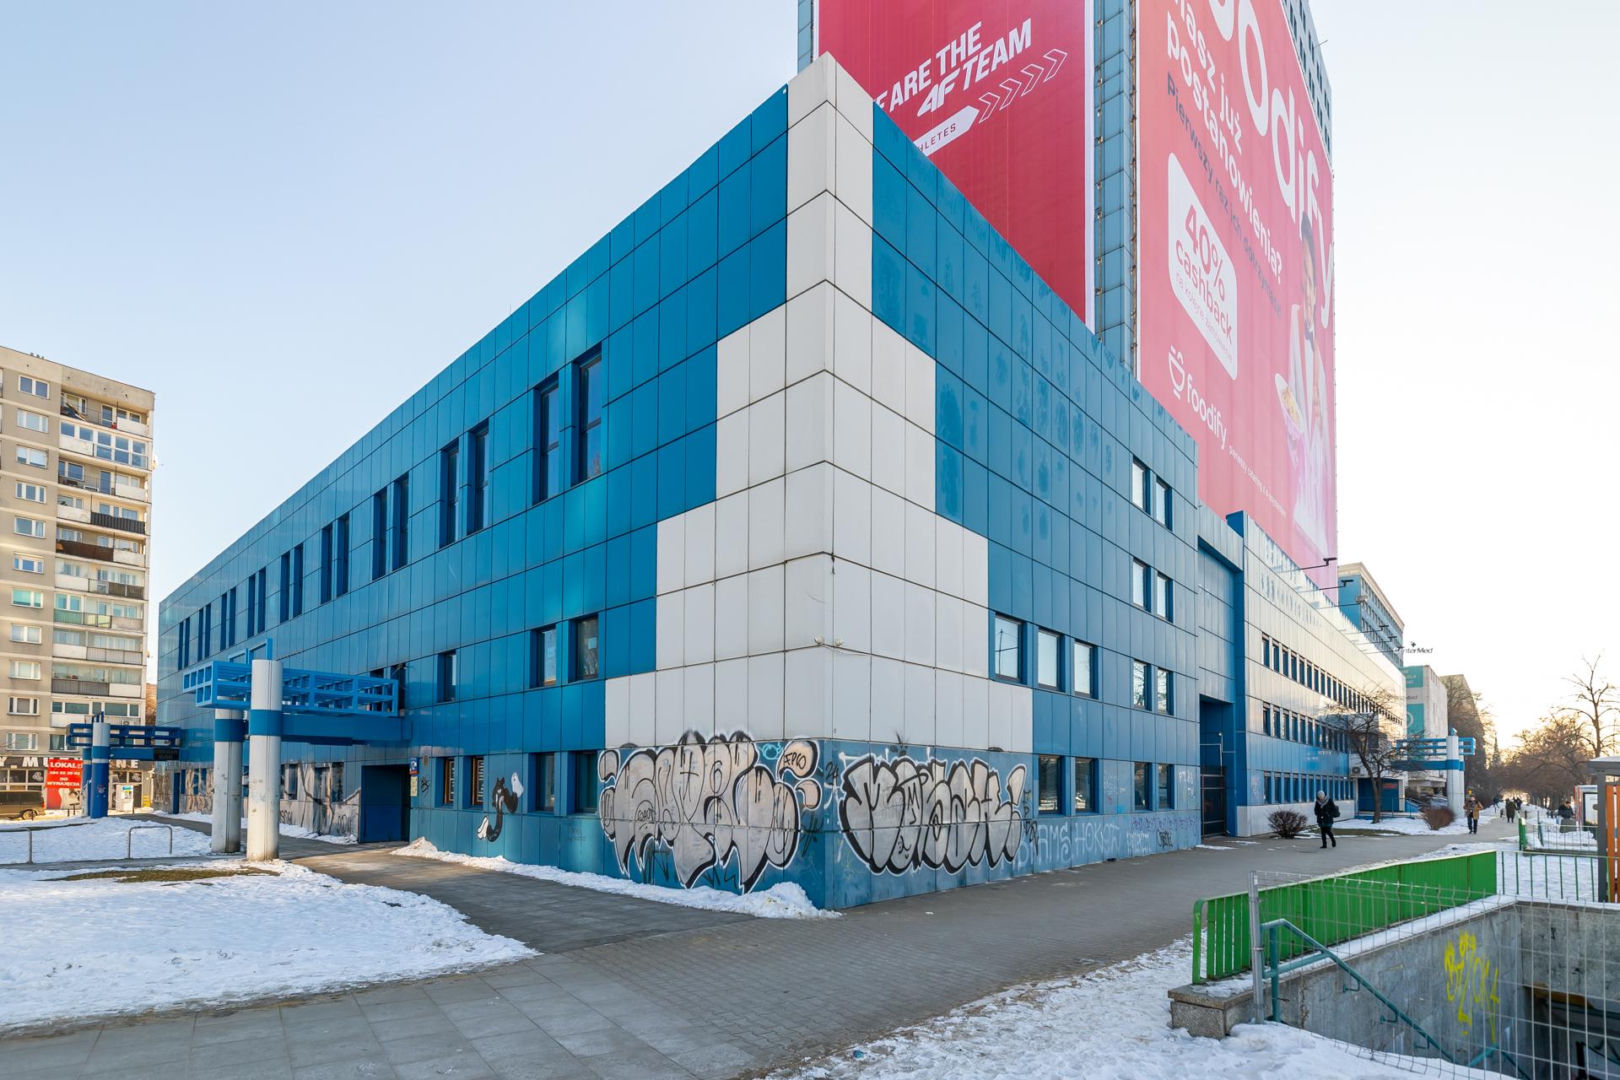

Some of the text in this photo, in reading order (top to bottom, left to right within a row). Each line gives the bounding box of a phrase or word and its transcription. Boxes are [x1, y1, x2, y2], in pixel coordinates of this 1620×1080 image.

[889, 58, 932, 113] ARE
[936, 20, 982, 76] THE
[962, 17, 1032, 91] TEAM
[1167, 10, 1283, 285] postanowienia?
[1220, 71, 1242, 156] już
[1207, 0, 1335, 329] odify
[1175, 239, 1232, 345] cashback
[1185, 204, 1226, 303] 40%
[1187, 373, 1227, 450] foodify
